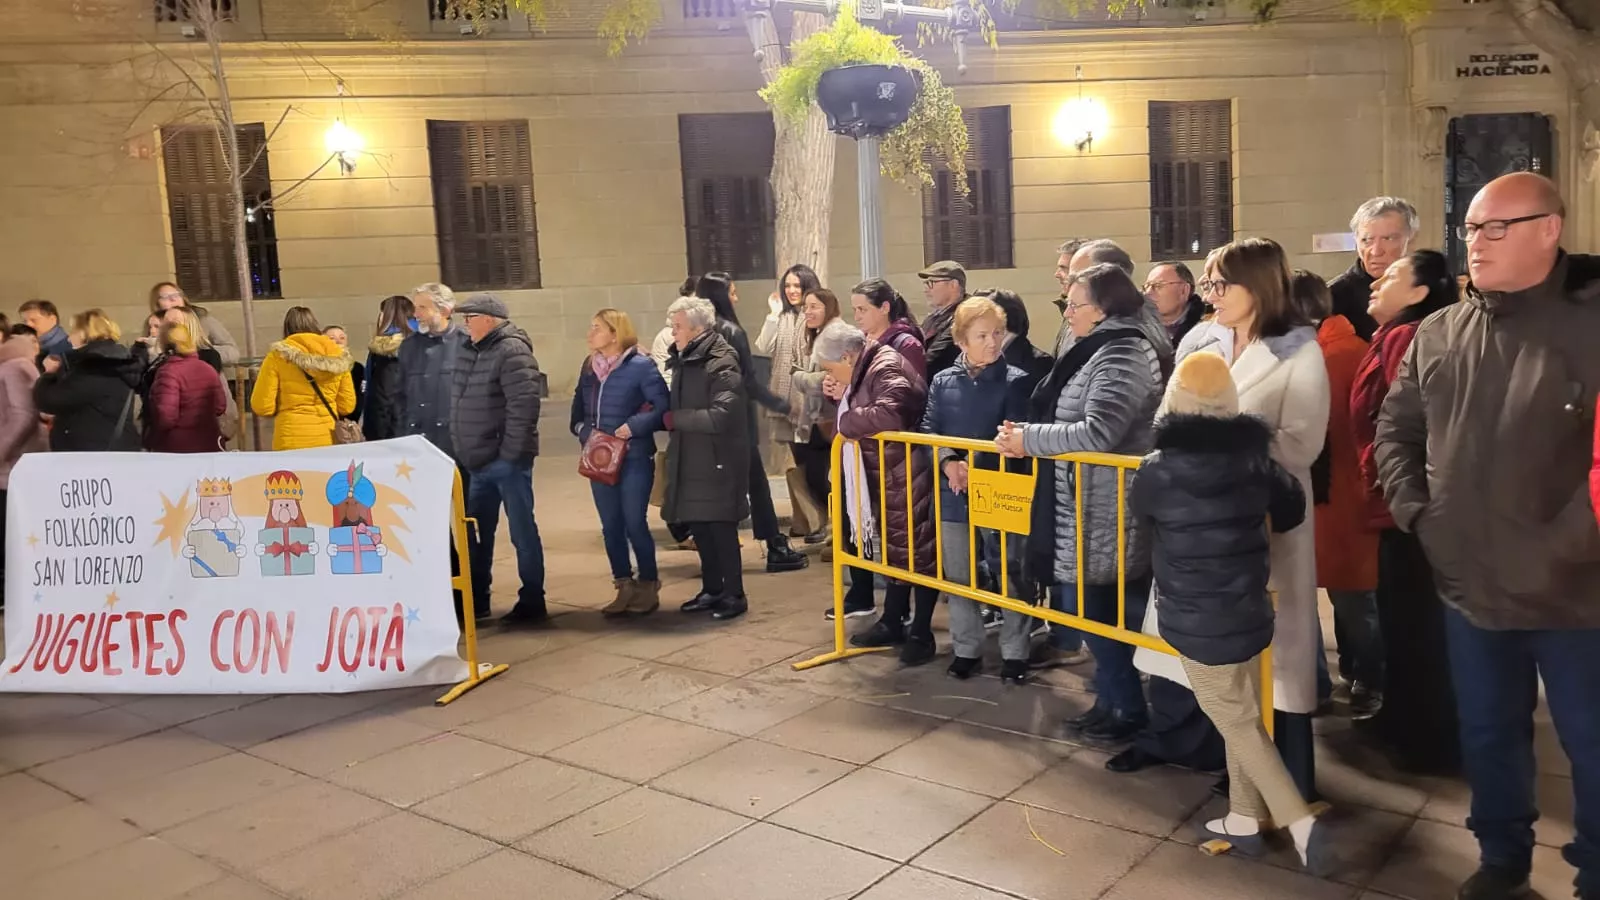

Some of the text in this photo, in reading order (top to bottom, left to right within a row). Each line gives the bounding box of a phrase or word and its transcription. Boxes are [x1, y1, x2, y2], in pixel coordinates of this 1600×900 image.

[1456, 64, 1551, 78] HACIENDA
[60, 477, 113, 509] GRUPO
[45, 512, 136, 548] FOLKLÓRICO
[33, 554, 143, 586] SAN LORENZO
[9, 602, 405, 676] JUGUETES CON JOTA
